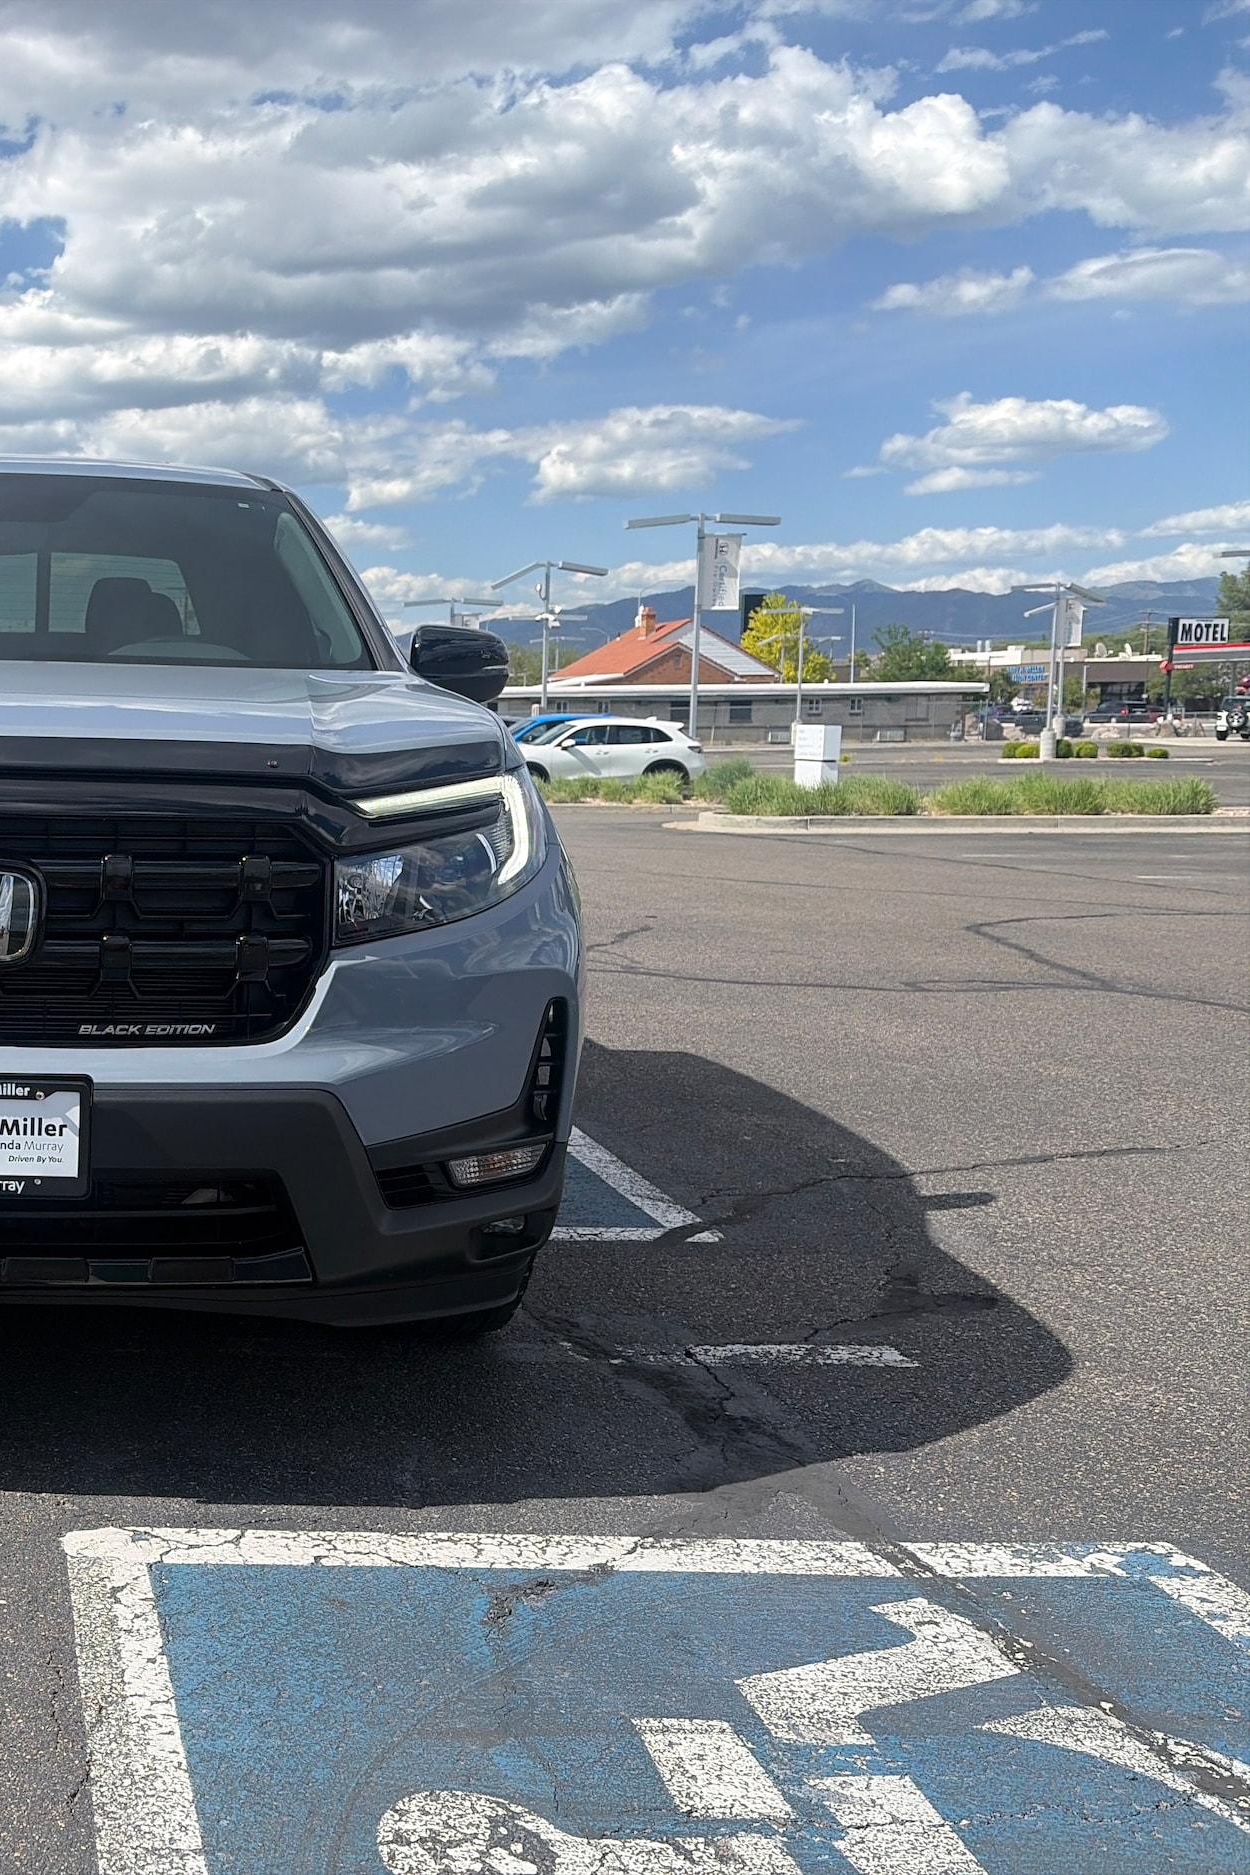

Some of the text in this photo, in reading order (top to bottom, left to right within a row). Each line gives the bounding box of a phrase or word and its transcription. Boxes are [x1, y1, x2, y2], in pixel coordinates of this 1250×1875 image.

[1180, 623, 1227, 642] MOTEL
[78, 1024, 216, 1035] BLACK EDITION
[0, 1117, 68, 1137] Miller
[23, 1141, 64, 1153] Murray
[8, 1155, 64, 1164] Driven By You.
